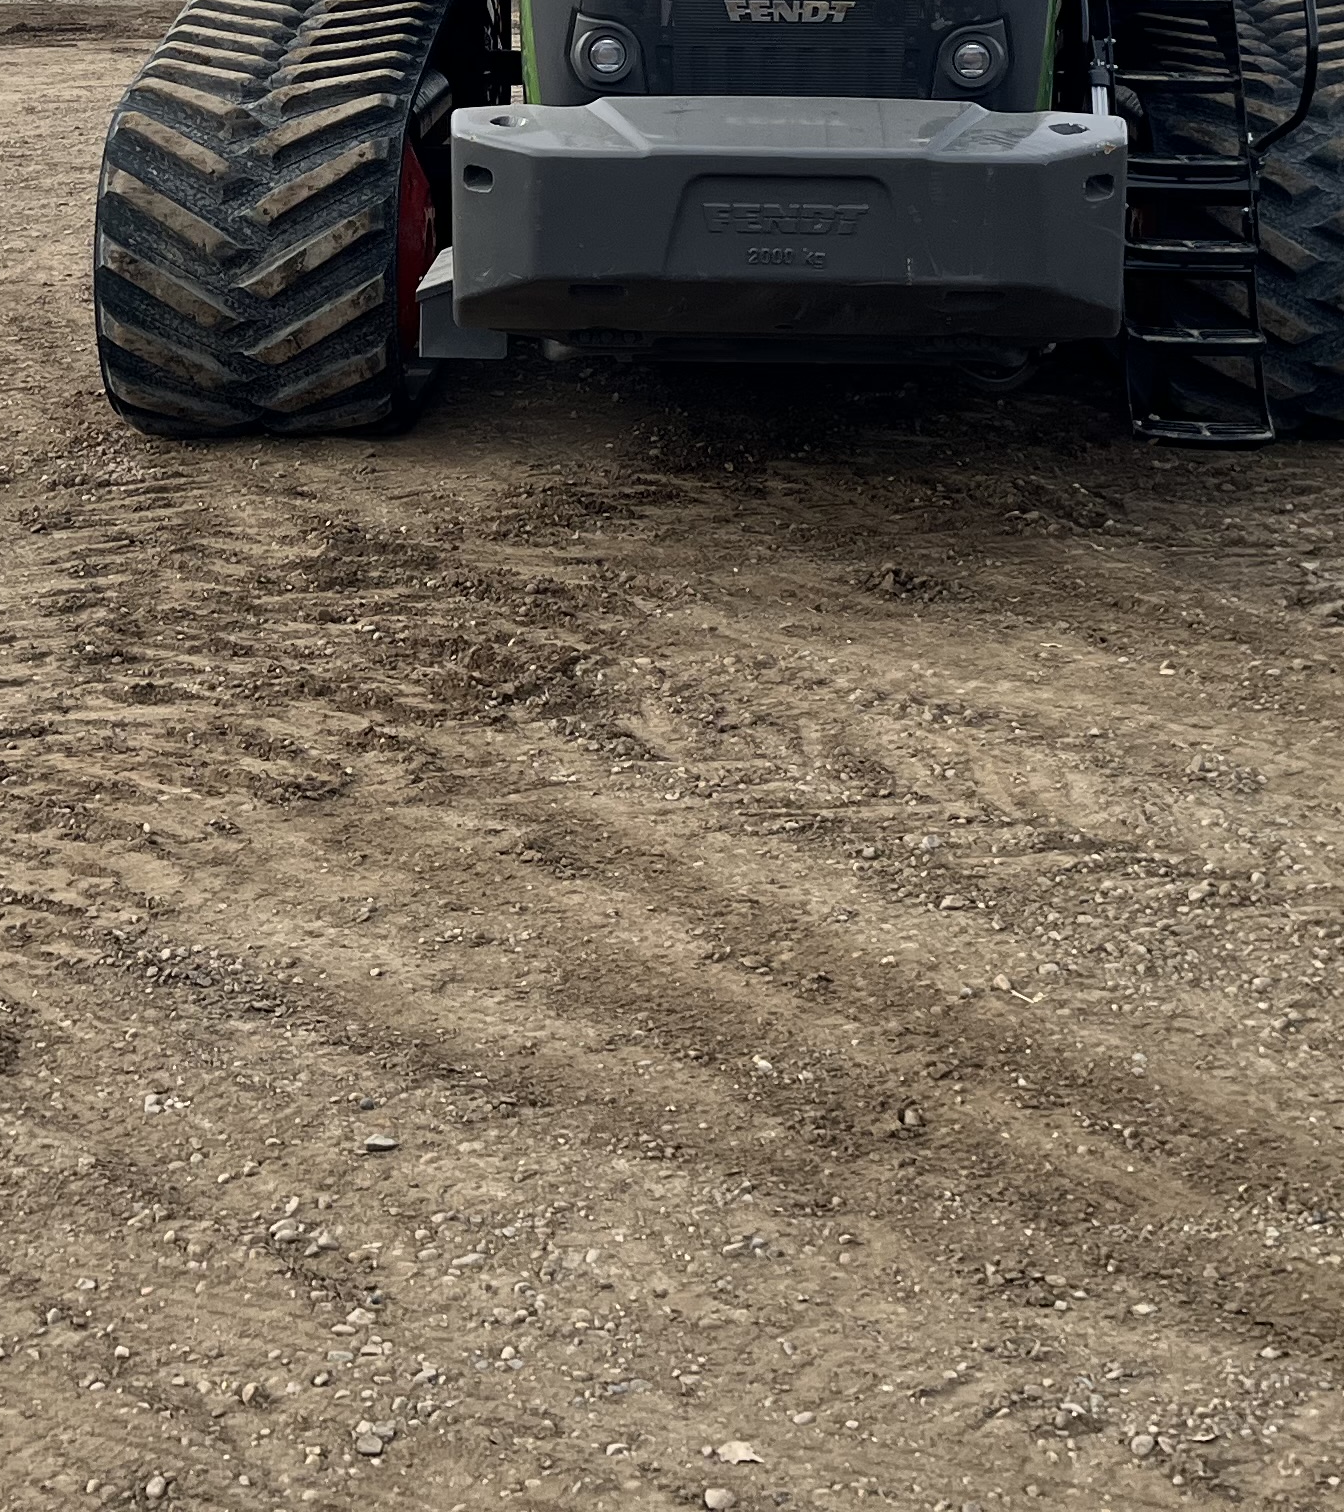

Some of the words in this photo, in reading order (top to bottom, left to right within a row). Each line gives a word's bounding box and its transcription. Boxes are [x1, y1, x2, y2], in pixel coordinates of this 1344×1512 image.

[723, 0, 857, 23] FENDT
[703, 202, 870, 235] FENDT
[747, 247, 794, 264] 2000
[803, 247, 826, 272] kg
